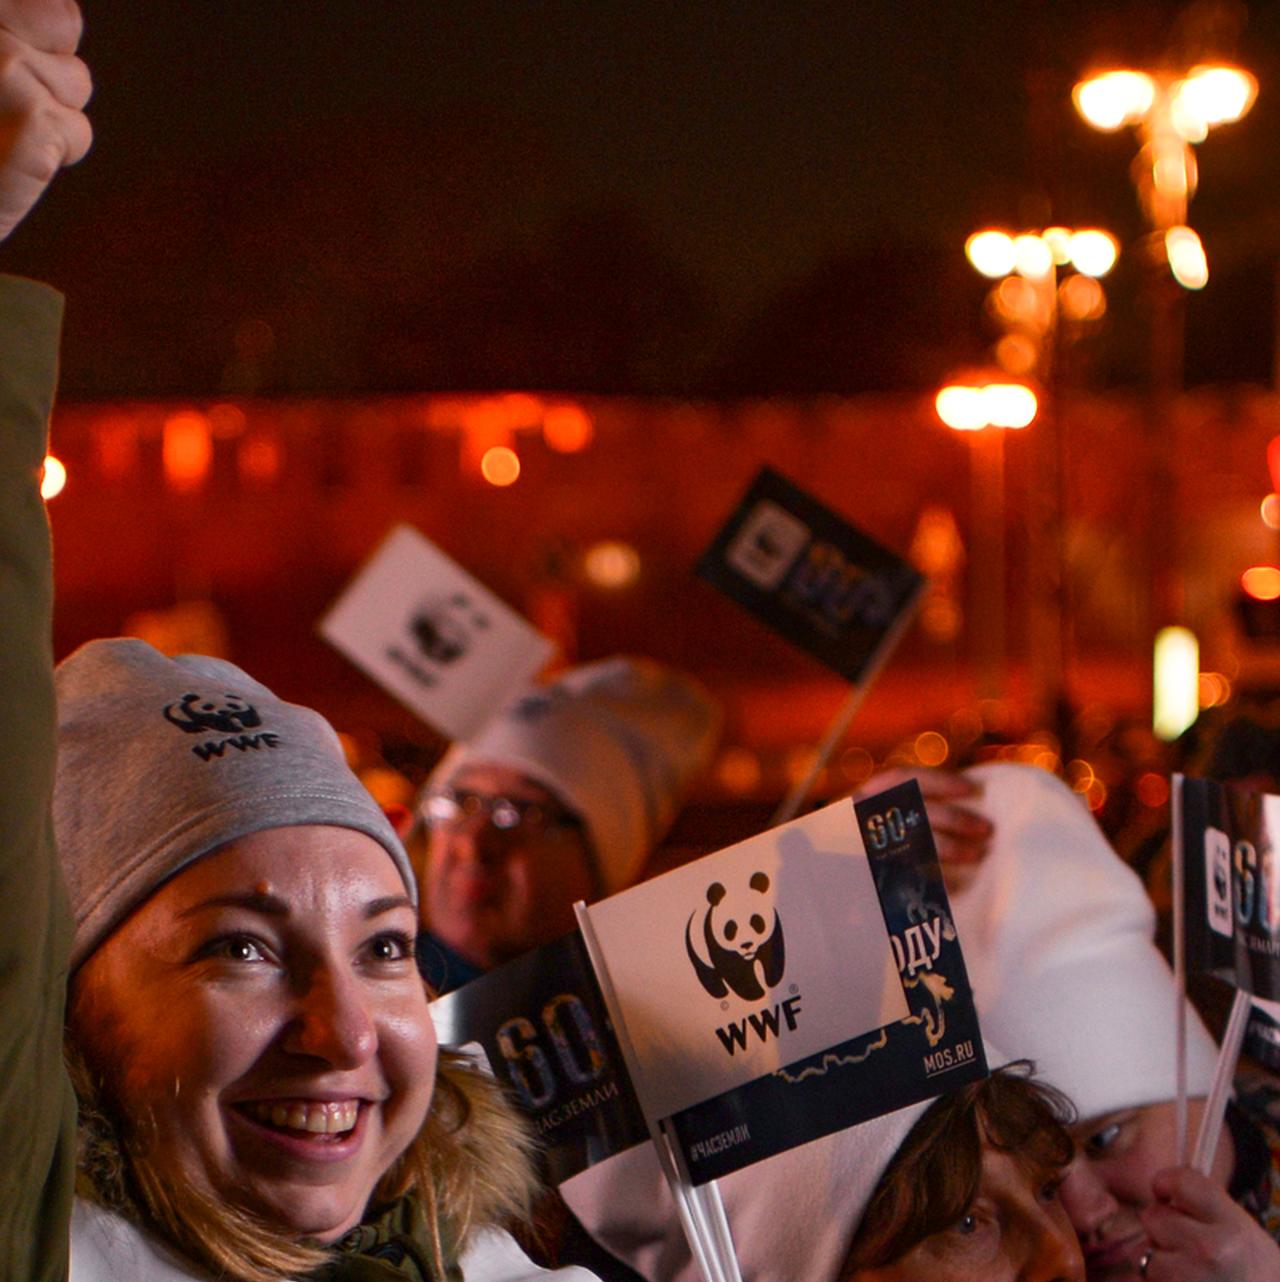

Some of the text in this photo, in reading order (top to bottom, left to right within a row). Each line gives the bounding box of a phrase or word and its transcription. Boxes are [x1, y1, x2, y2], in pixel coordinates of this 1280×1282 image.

[191, 732, 283, 762] WWF
[715, 995, 802, 1057] WWF
[923, 1040, 975, 1075] MOS.RU
